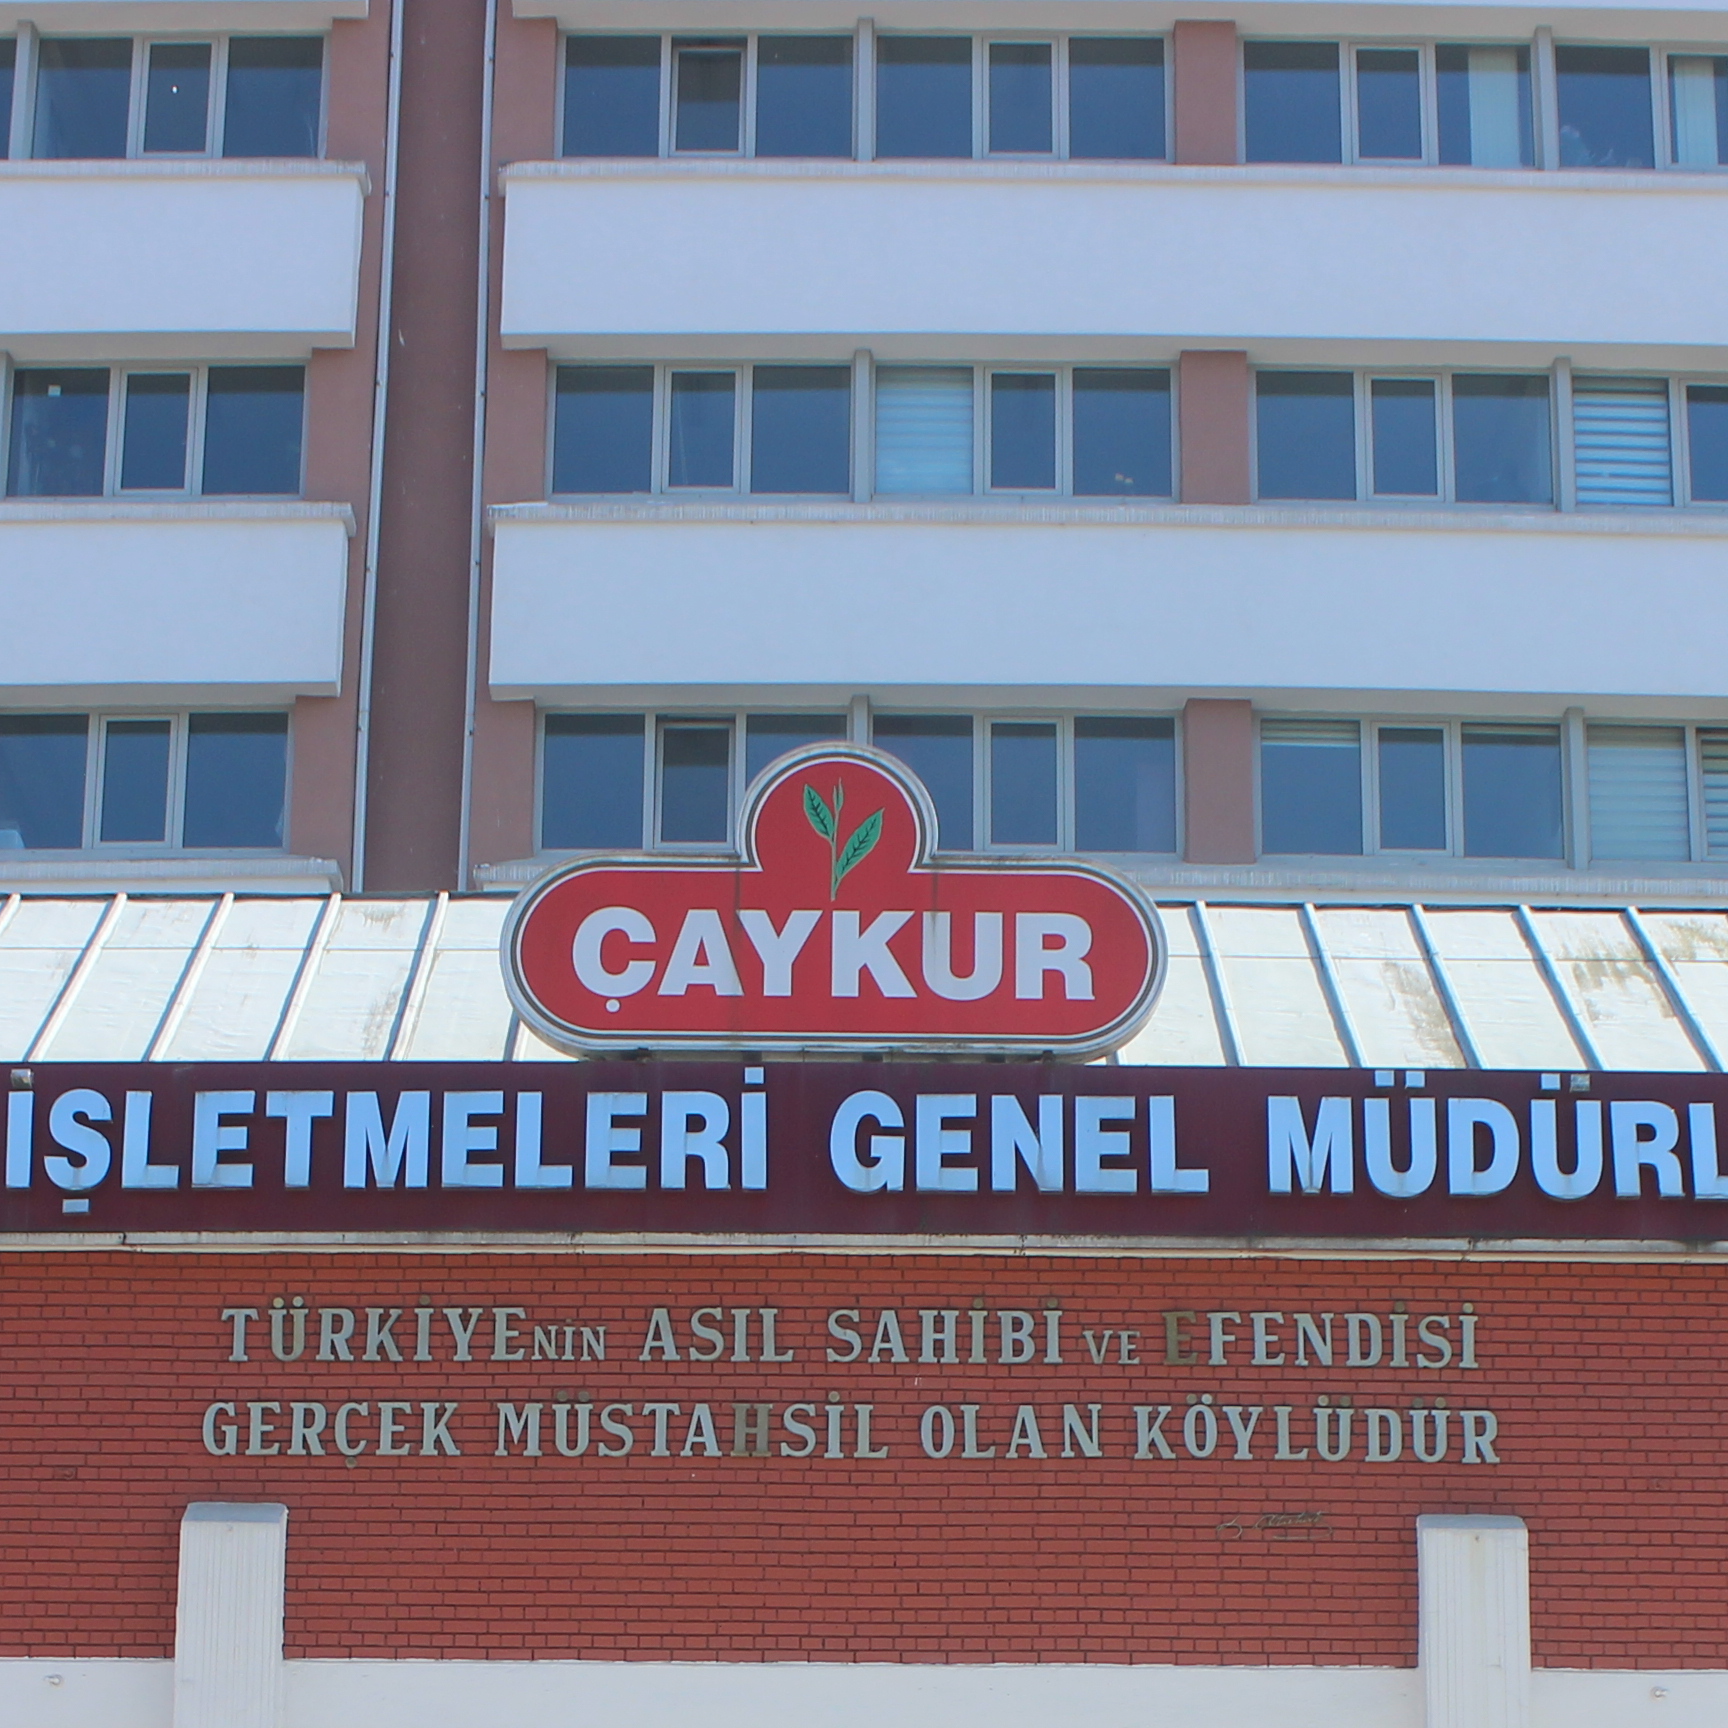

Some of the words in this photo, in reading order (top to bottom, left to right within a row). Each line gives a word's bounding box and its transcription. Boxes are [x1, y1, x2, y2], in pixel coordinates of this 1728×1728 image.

[572, 906, 1096, 1013] ÇAYKUR
[5, 1066, 768, 1213] İŞLETMELERİ
[830, 1090, 1210, 1194] GENEL
[639, 1307, 795, 1363] ASIL
[826, 1298, 1064, 1365] SAHİBİ
[1082, 1330, 1141, 1365] VE
[1161, 1302, 1479, 1369] EFENDİSİ
[202, 1400, 462, 1469] GERÇEK
[494, 1391, 889, 1459] MÜSTAHSİL
[920, 1404, 1103, 1459] OLAN
[1133, 1393, 1501, 1464] KÖYLÜDÜR
